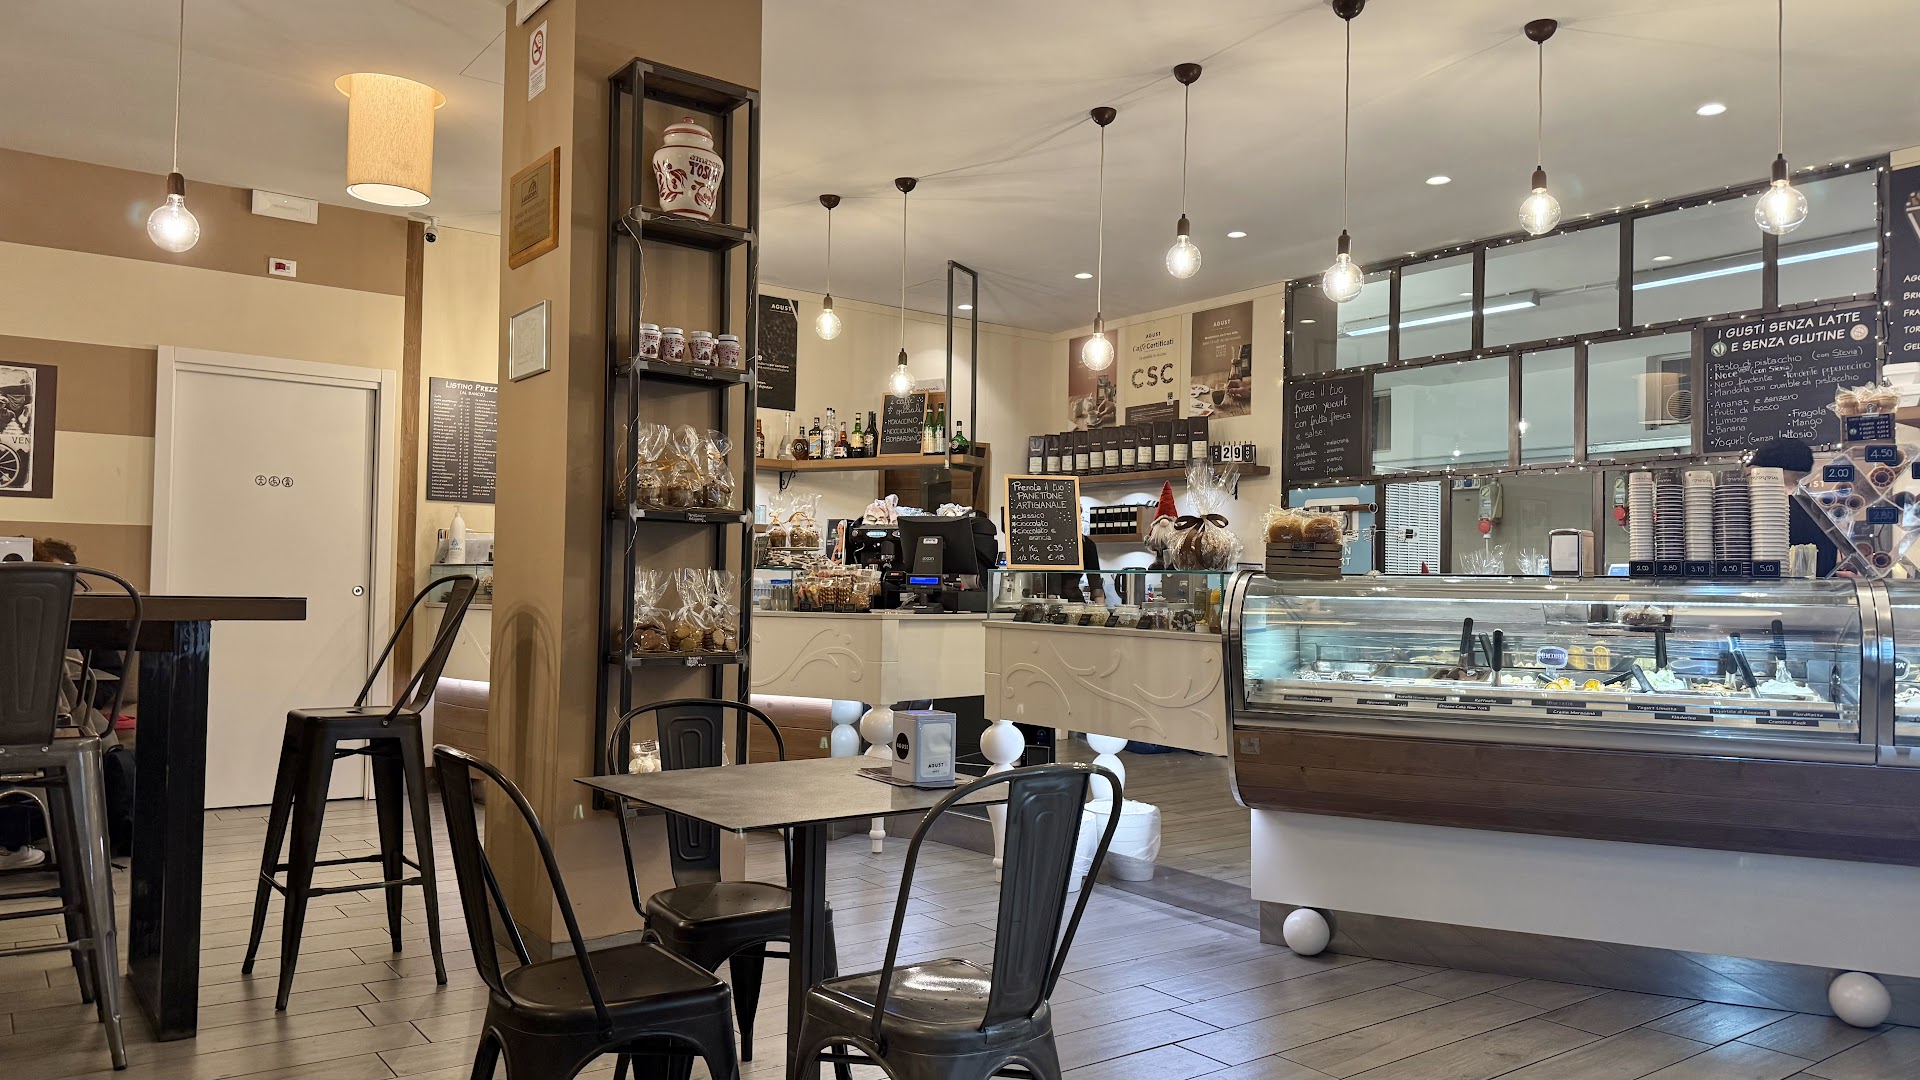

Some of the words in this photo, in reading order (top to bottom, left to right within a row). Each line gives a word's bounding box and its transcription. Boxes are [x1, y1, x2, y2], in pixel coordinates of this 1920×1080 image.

[1726, 325, 1764, 338] GUSTI
[1768, 317, 1814, 332] SENZA
[1818, 312, 1860, 326] LATTE
[1731, 342, 1738, 352] E
[1742, 338, 1785, 352] SENZA
[1788, 328, 1846, 344] GLUTINE
[1754, 354, 1802, 368] pistacchio
[1132, 362, 1174, 389] CSC
[1715, 372, 1738, 380] Noce
[1714, 380, 1734, 388] Nero
[1816, 374, 1860, 388] pistacchio
[1296, 390, 1315, 400] Crea
[1330, 384, 1344, 396] tuo
[1714, 399, 1750, 408] Ananas
[1753, 404, 1780, 412] bosco
[1792, 406, 1827, 418] Fragola
[1294, 420, 1306, 428] con
[1329, 412, 1351, 426] fresca
[1715, 416, 1748, 426] Limone
[1792, 418, 1823, 428] Mango
[1716, 425, 1746, 434] Banana
[1714, 435, 1746, 448] Yogurt
[1870, 448, 1892, 458] 4.50
[1828, 468, 1848, 478] 2.00
[1012, 482, 1041, 491] Prenota
[1053, 482, 1064, 491] tuo
[1016, 500, 1067, 509] ARTIGIANALE
